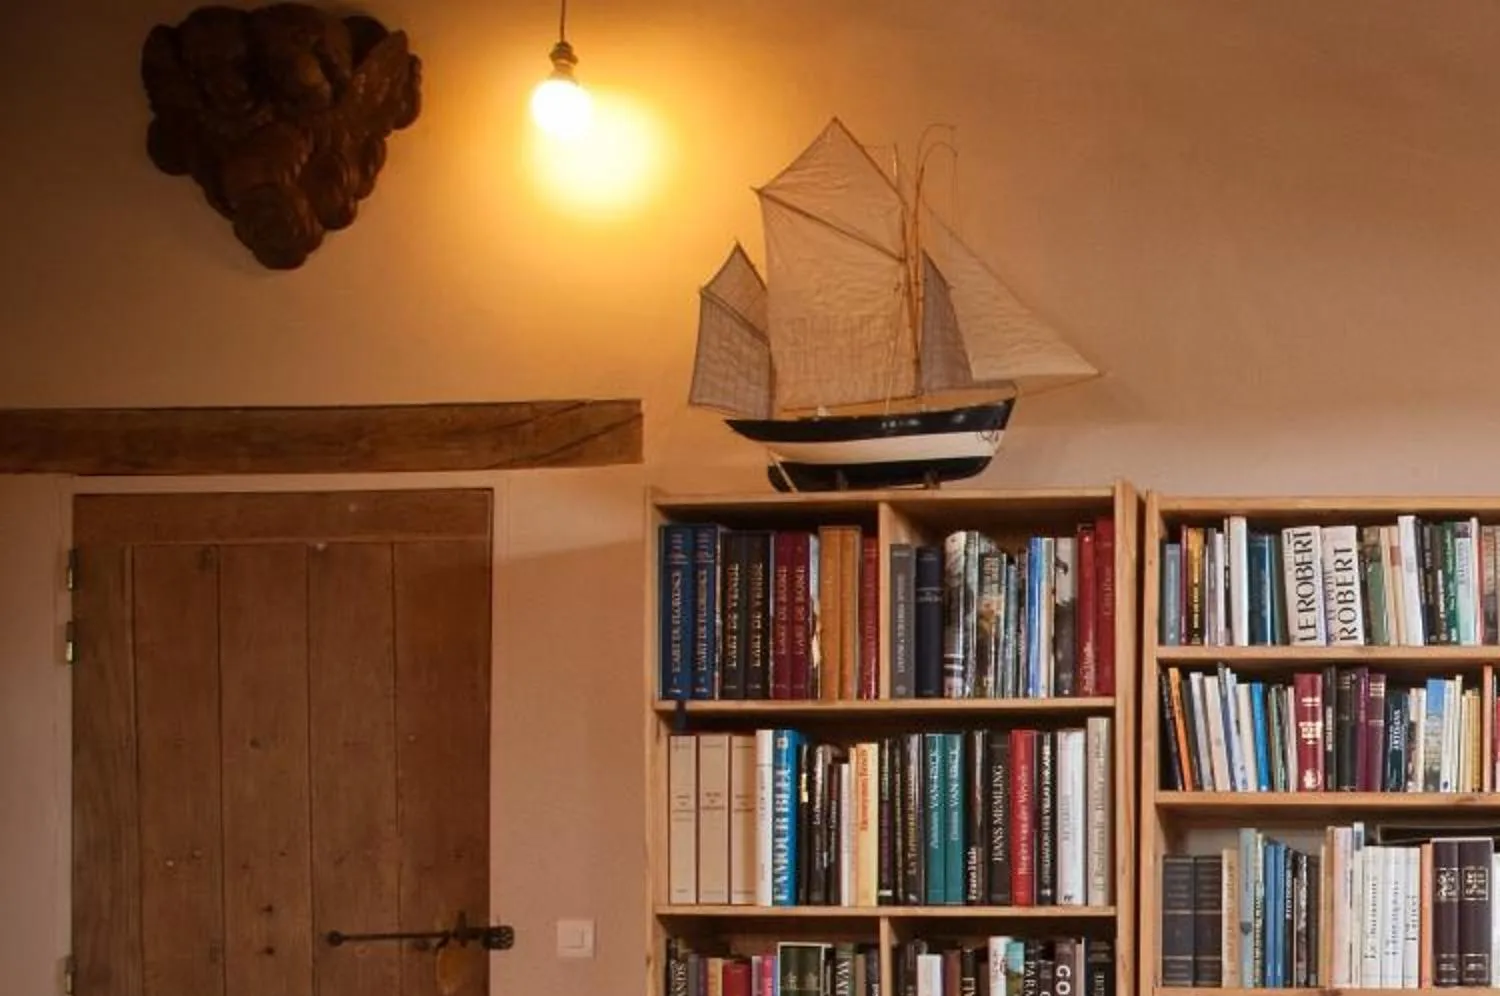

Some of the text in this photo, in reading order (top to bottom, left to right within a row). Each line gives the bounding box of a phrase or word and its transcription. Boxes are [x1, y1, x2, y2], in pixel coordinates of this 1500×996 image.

[1293, 531, 1317, 641] LE ROBERT
[1334, 548, 1358, 641] ROBERT
[992, 764, 1004, 861] HANS MEMLING
